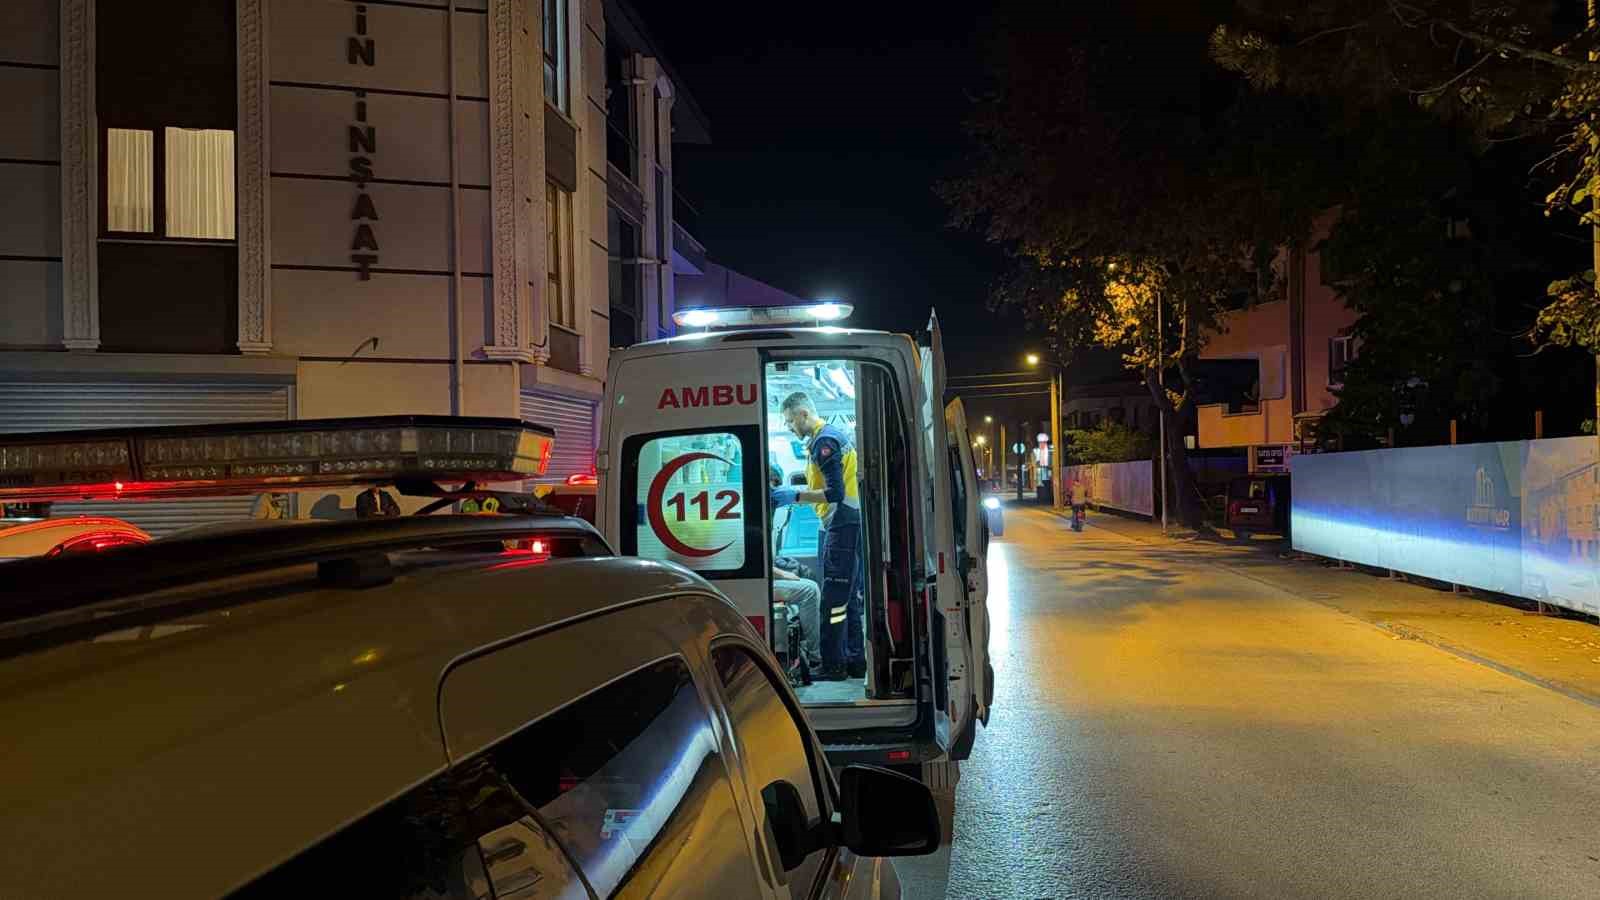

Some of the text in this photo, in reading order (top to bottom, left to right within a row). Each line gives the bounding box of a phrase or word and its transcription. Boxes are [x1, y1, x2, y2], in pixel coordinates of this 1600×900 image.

[348, 89, 379, 281] İNŞAAT
[656, 383, 758, 410] AMBU
[666, 489, 741, 522] 112
